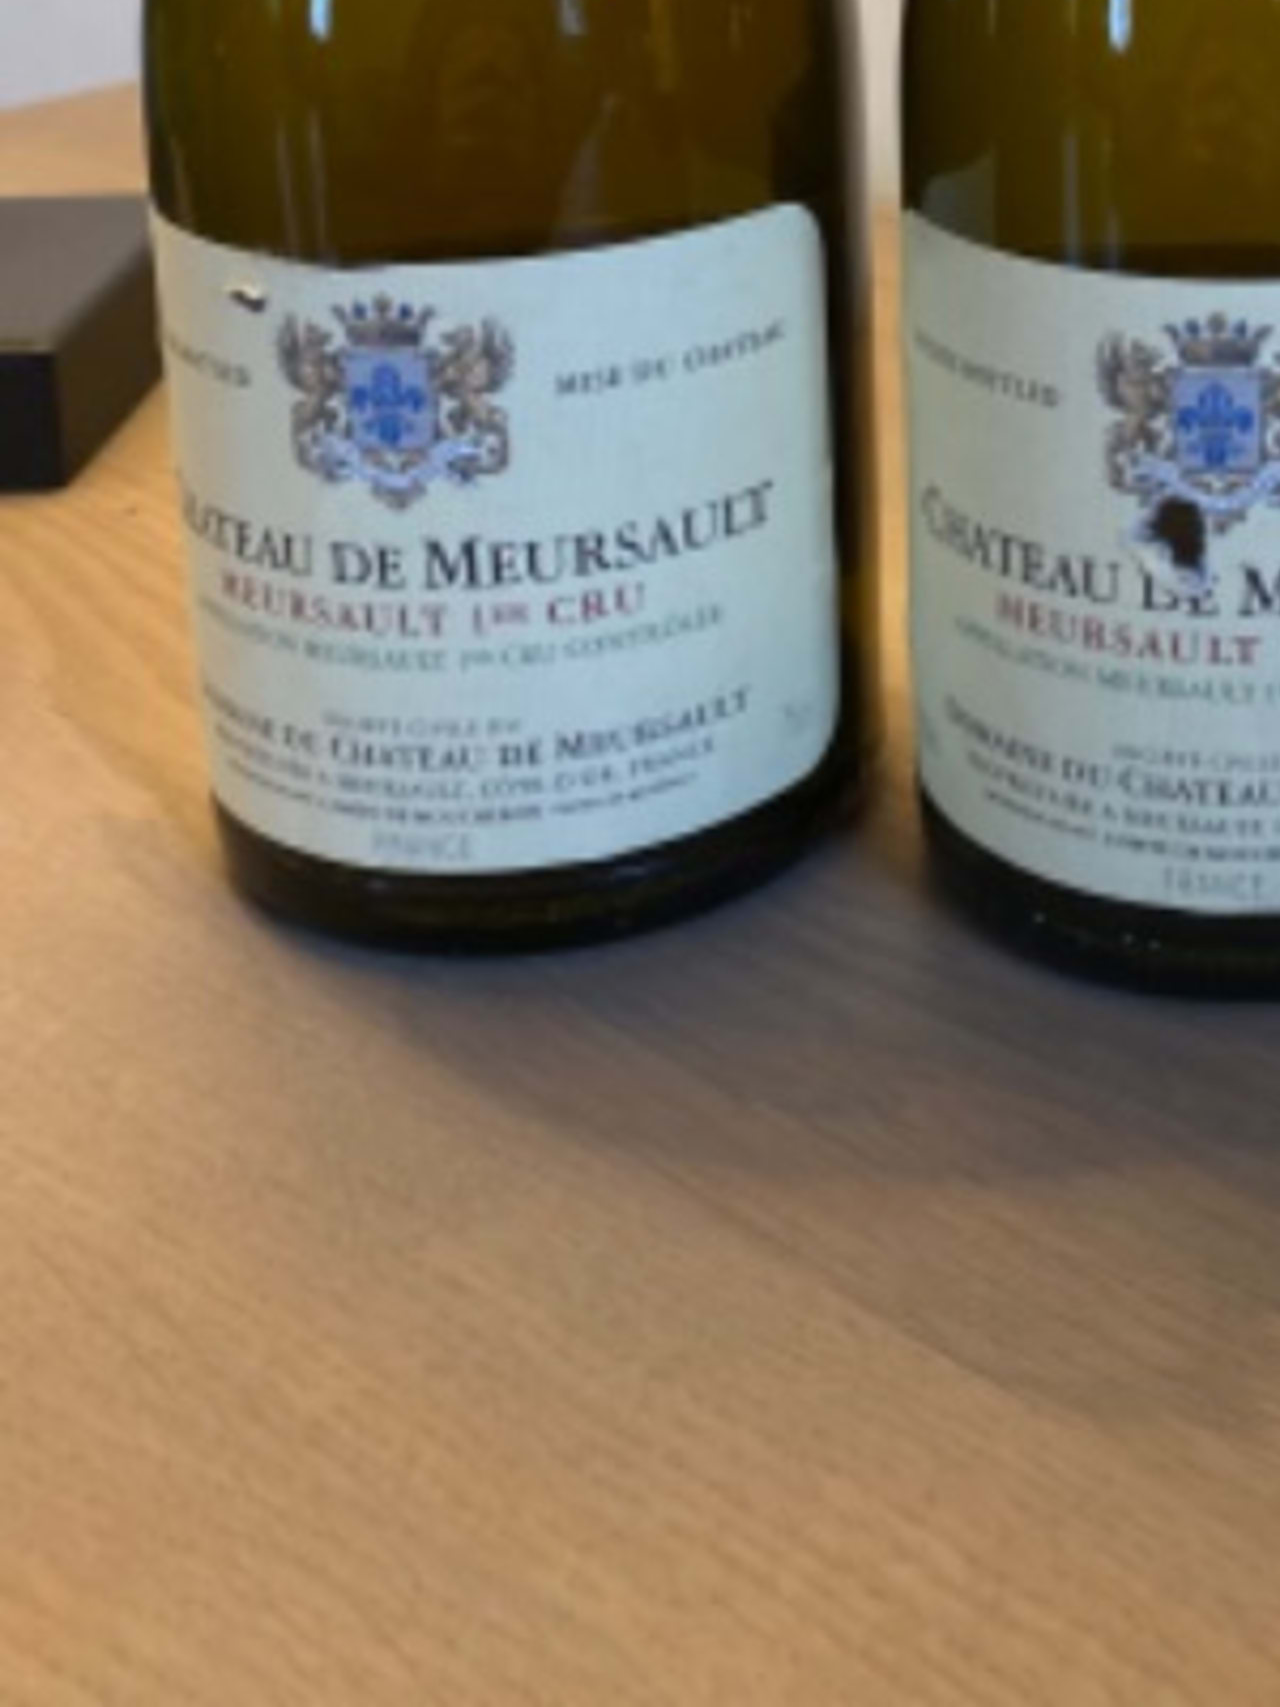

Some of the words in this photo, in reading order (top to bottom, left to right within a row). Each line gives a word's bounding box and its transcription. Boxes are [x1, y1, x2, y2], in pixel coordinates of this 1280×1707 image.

[333, 540, 406, 589] DE
[424, 478, 774, 592] MEURSAULT
[921, 482, 1123, 607] CHATEAU
[221, 572, 447, 640] MEURSAULT
[547, 581, 645, 626] CRU
[994, 592, 1262, 667] MEURSAULT
